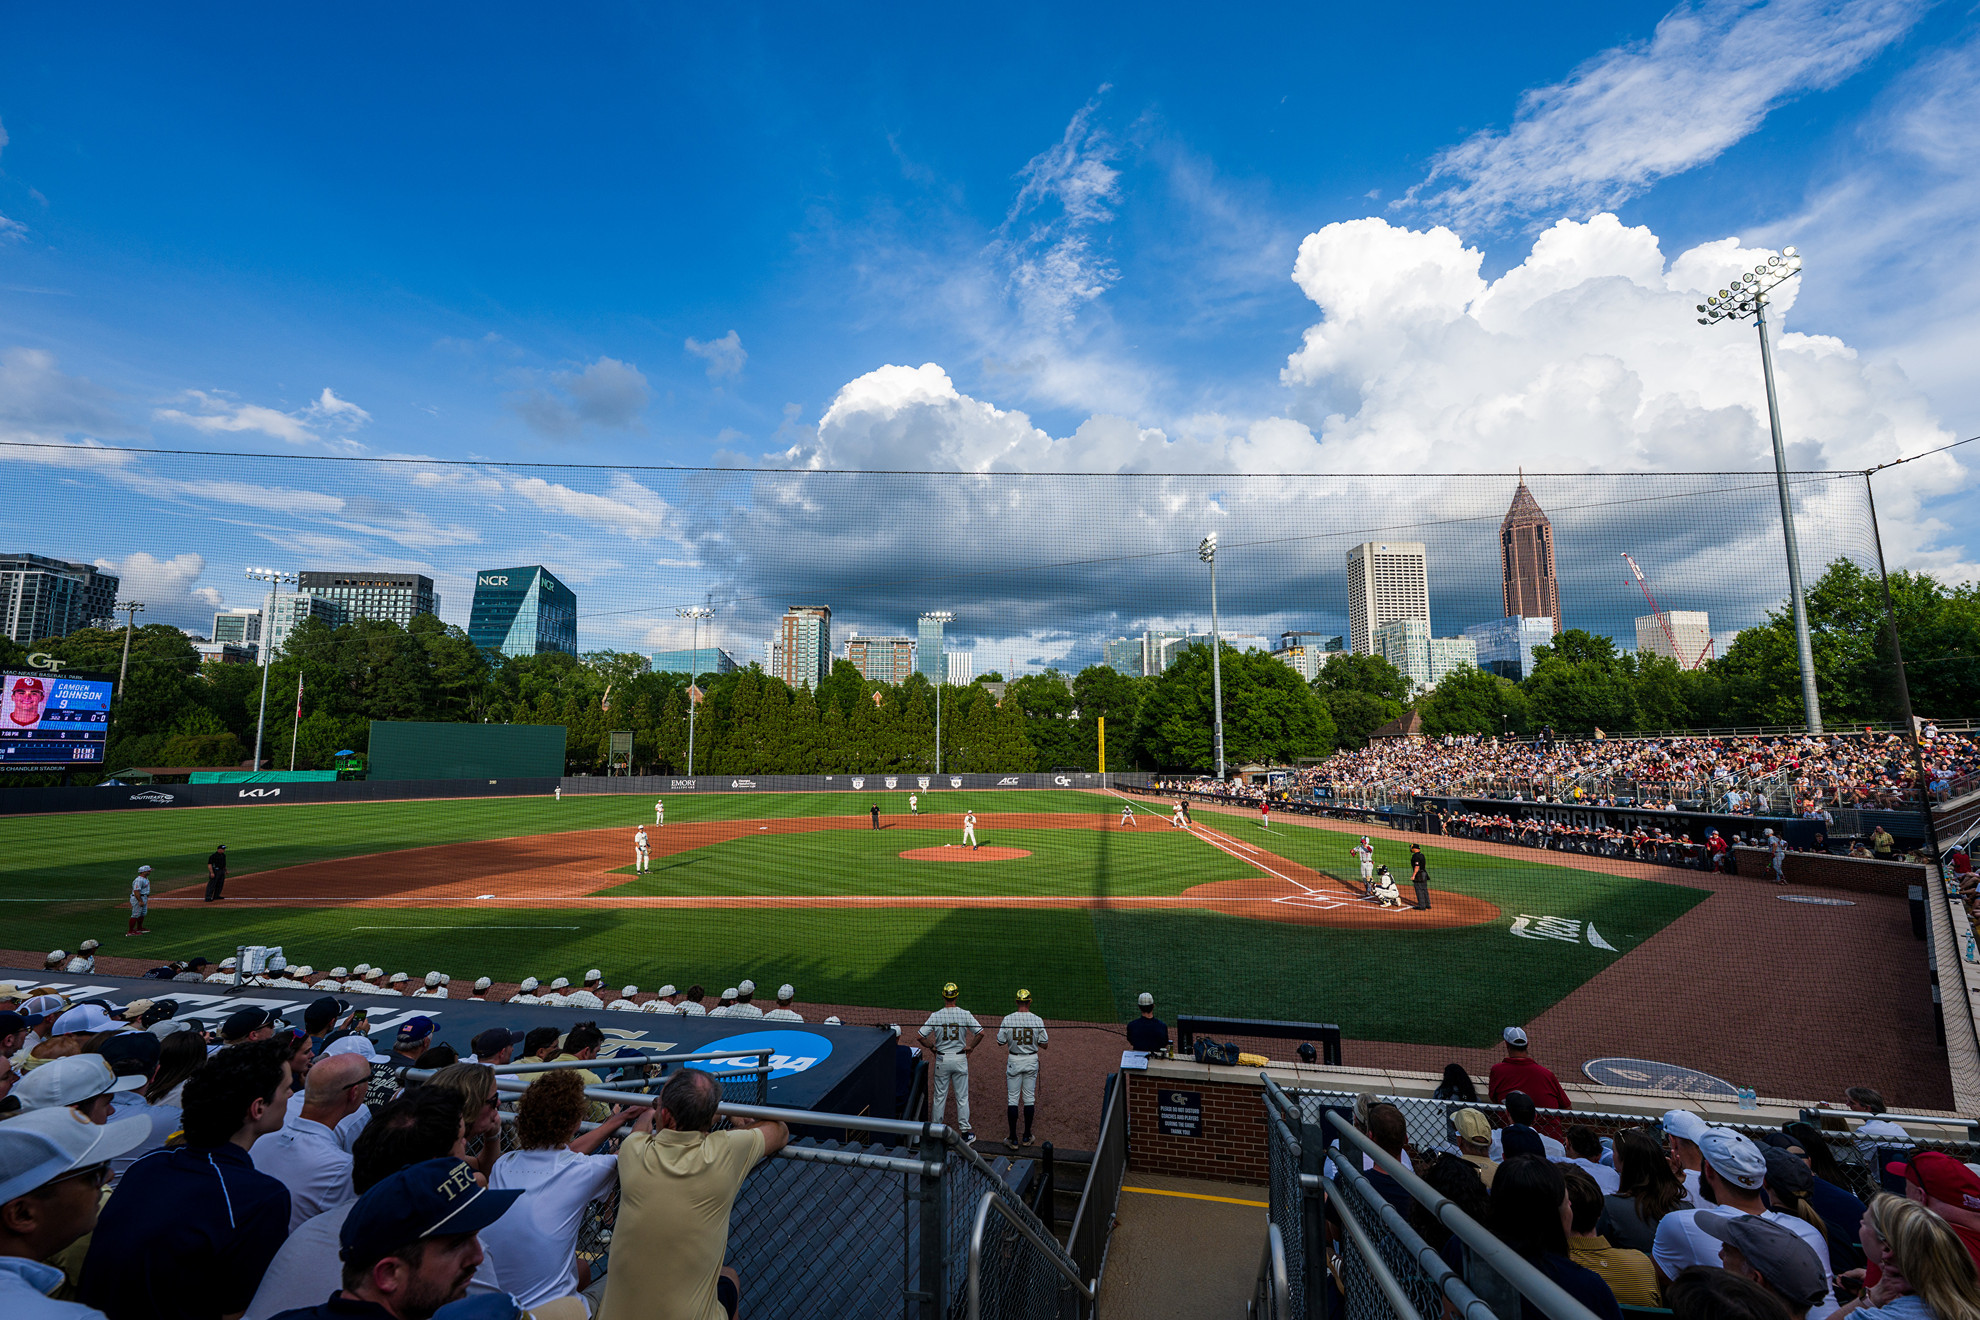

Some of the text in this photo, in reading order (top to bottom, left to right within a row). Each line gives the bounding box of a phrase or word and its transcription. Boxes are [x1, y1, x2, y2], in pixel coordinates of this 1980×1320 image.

[479, 575, 508, 586] NCR
[541, 577, 554, 592] NCR
[26, 652, 66, 672] GT
[58, 683, 90, 691] CAMDEN
[55, 690, 102, 700] JOHNSON
[59, 700, 68, 709] 9
[998, 777, 1019, 785] ACC
[1055, 776, 1071, 786] GT
[942, 1023, 959, 1041] 13
[1012, 1027, 1033, 1045] 48
[691, 1050, 817, 1072] NCAA
[1171, 1093, 1188, 1105] GT
[437, 1166, 476, 1201] TEC
